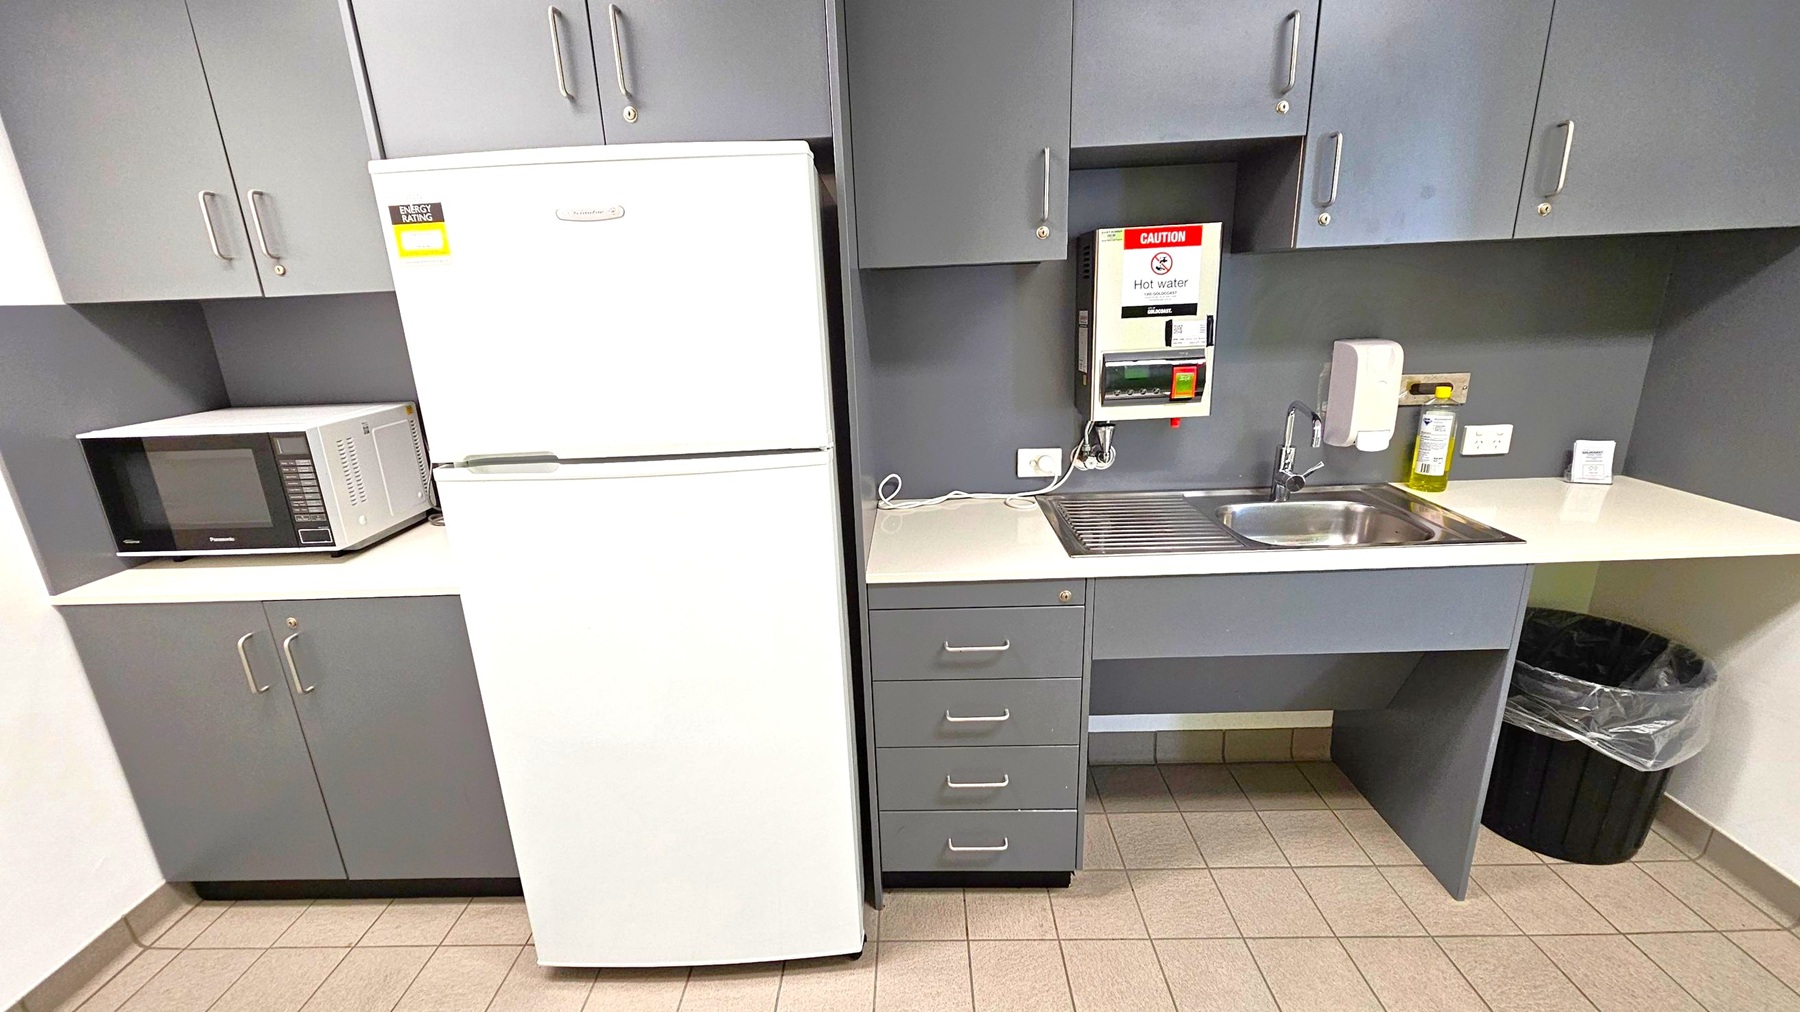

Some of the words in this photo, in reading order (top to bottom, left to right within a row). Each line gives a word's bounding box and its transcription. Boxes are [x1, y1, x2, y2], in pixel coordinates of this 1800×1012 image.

[399, 204, 432, 214] ENERGY
[401, 213, 433, 223] RATING
[1140, 230, 1186, 245] CAUTION
[1134, 279, 1153, 290] Hot
[1157, 278, 1189, 289] water
